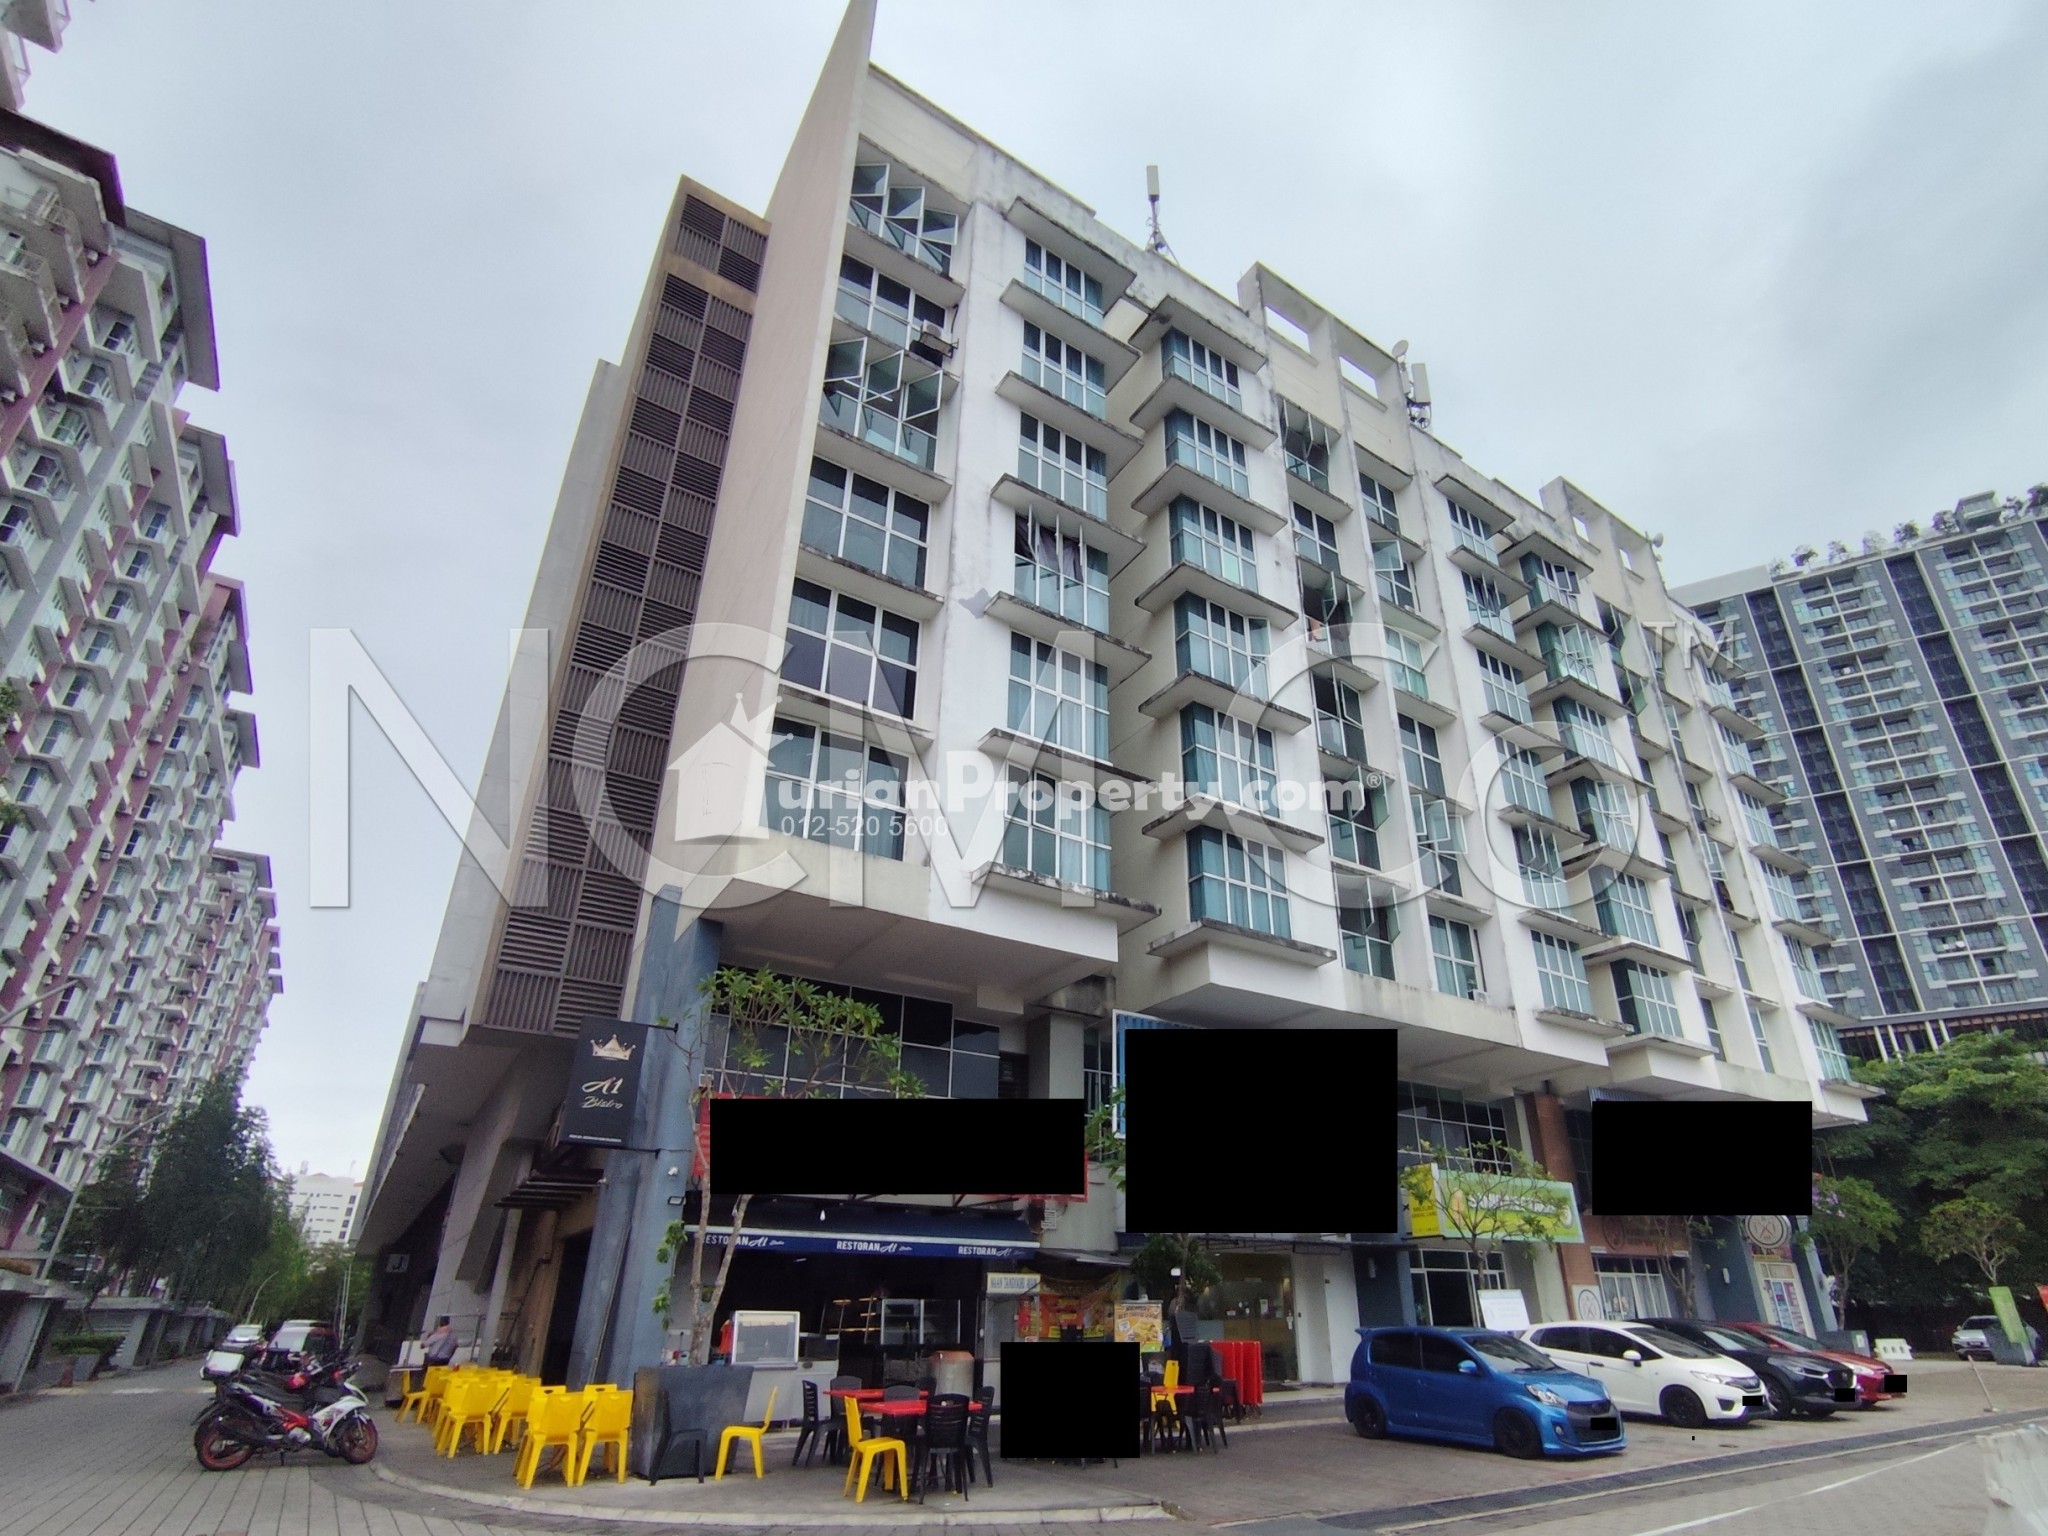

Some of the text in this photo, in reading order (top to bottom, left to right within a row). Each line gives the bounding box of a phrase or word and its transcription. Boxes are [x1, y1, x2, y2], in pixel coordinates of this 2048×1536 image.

[582, 1095, 624, 1109] Bistro
[702, 1234, 749, 1245] ESTOAN
[836, 1240, 880, 1252] RESTORAN
[958, 1245, 997, 1256] RESTORAN
